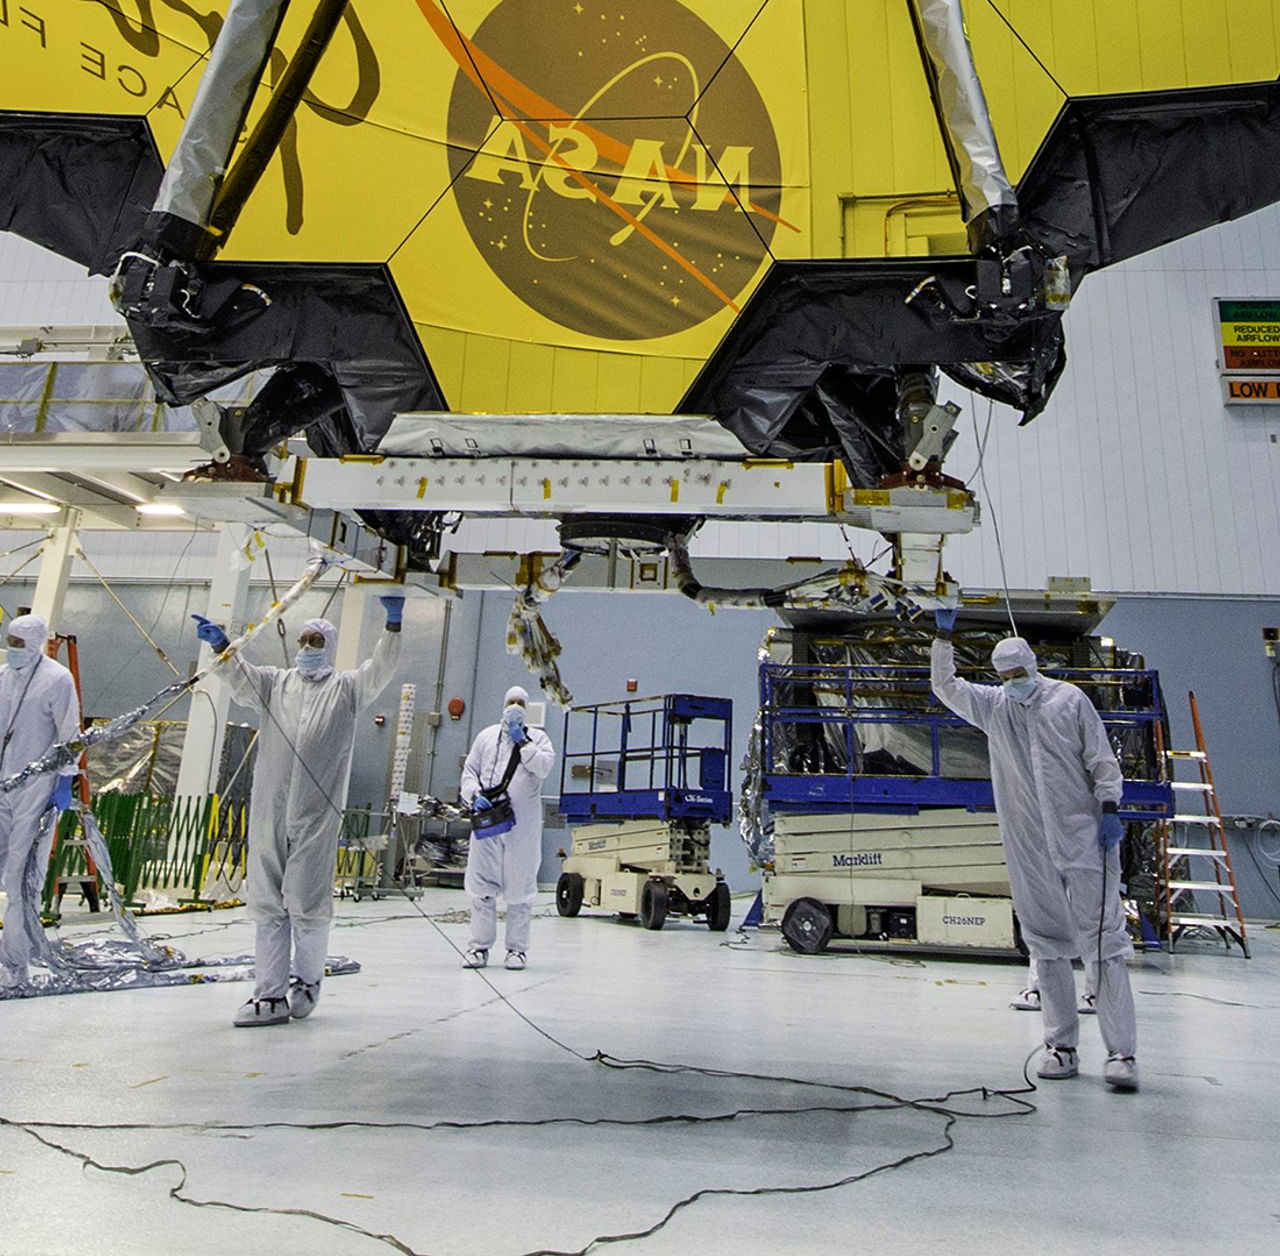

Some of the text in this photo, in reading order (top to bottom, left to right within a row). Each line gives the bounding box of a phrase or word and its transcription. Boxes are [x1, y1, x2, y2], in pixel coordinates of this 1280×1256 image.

[1233, 310, 1277, 319] AIRFLOW
[1233, 325, 1280, 334] REDUCED
[1236, 334, 1280, 342] AIRFLOW
[1229, 382, 1268, 398] LOW
[832, 852, 883, 867] Marklift
